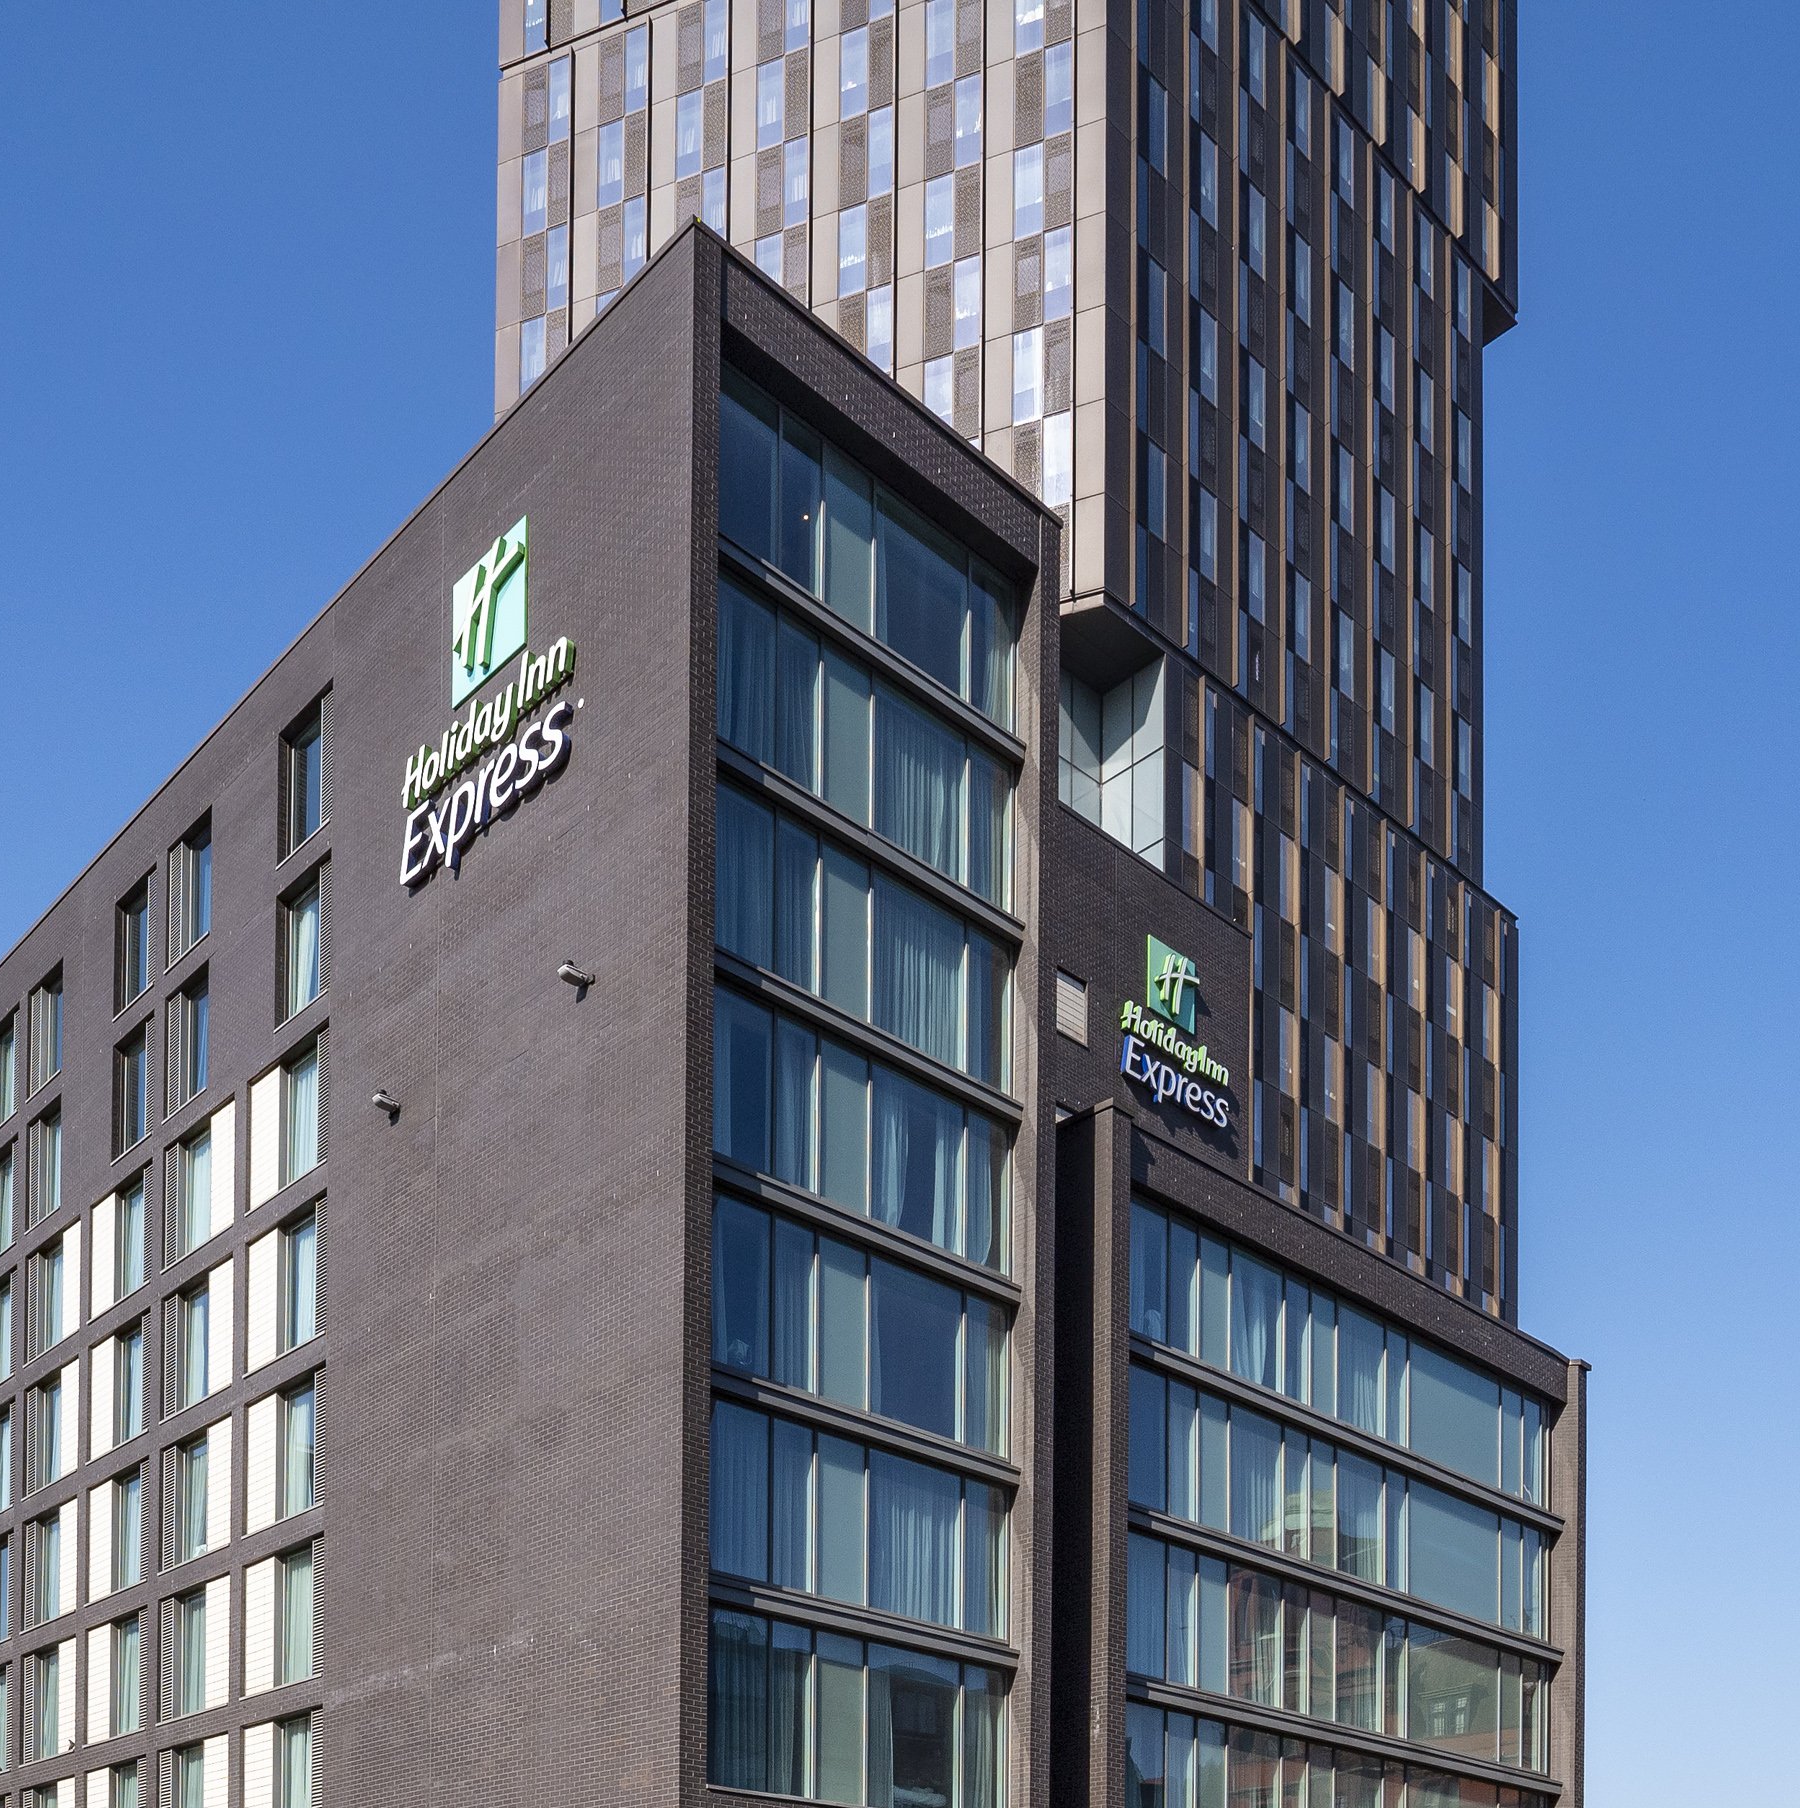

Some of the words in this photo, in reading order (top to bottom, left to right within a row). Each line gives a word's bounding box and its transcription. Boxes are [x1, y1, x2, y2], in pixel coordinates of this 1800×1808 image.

[402, 683, 516, 808] Holiday
[519, 637, 574, 707] Inn
[400, 702, 573, 885] Express
[1121, 1000, 1199, 1072] Holiday
[1198, 1044, 1229, 1086] Inn
[1121, 1034, 1229, 1128] Express
